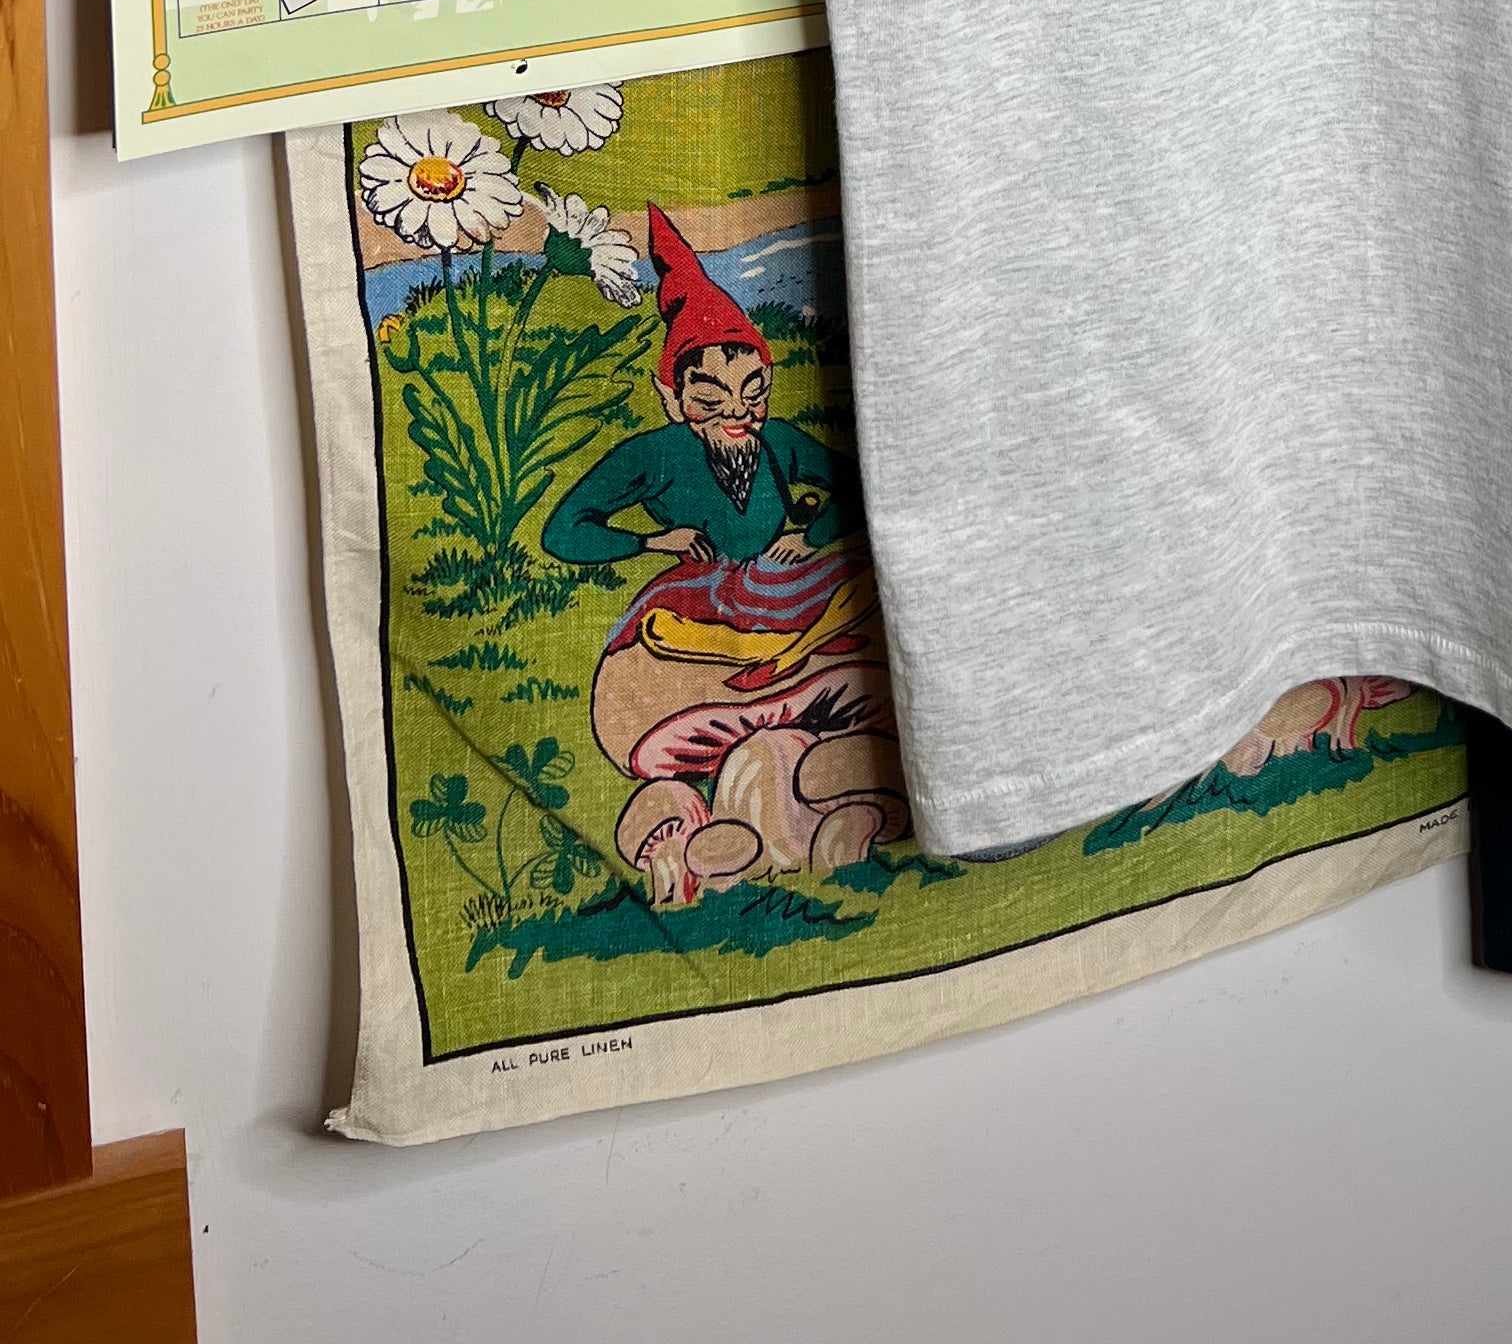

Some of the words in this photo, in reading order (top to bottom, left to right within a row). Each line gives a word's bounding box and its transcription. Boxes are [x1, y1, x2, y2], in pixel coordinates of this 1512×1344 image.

[1419, 809, 1458, 833] MADE
[491, 1060, 518, 1073] ALL
[529, 1048, 569, 1065] PURE
[581, 1037, 632, 1056] LINEN
